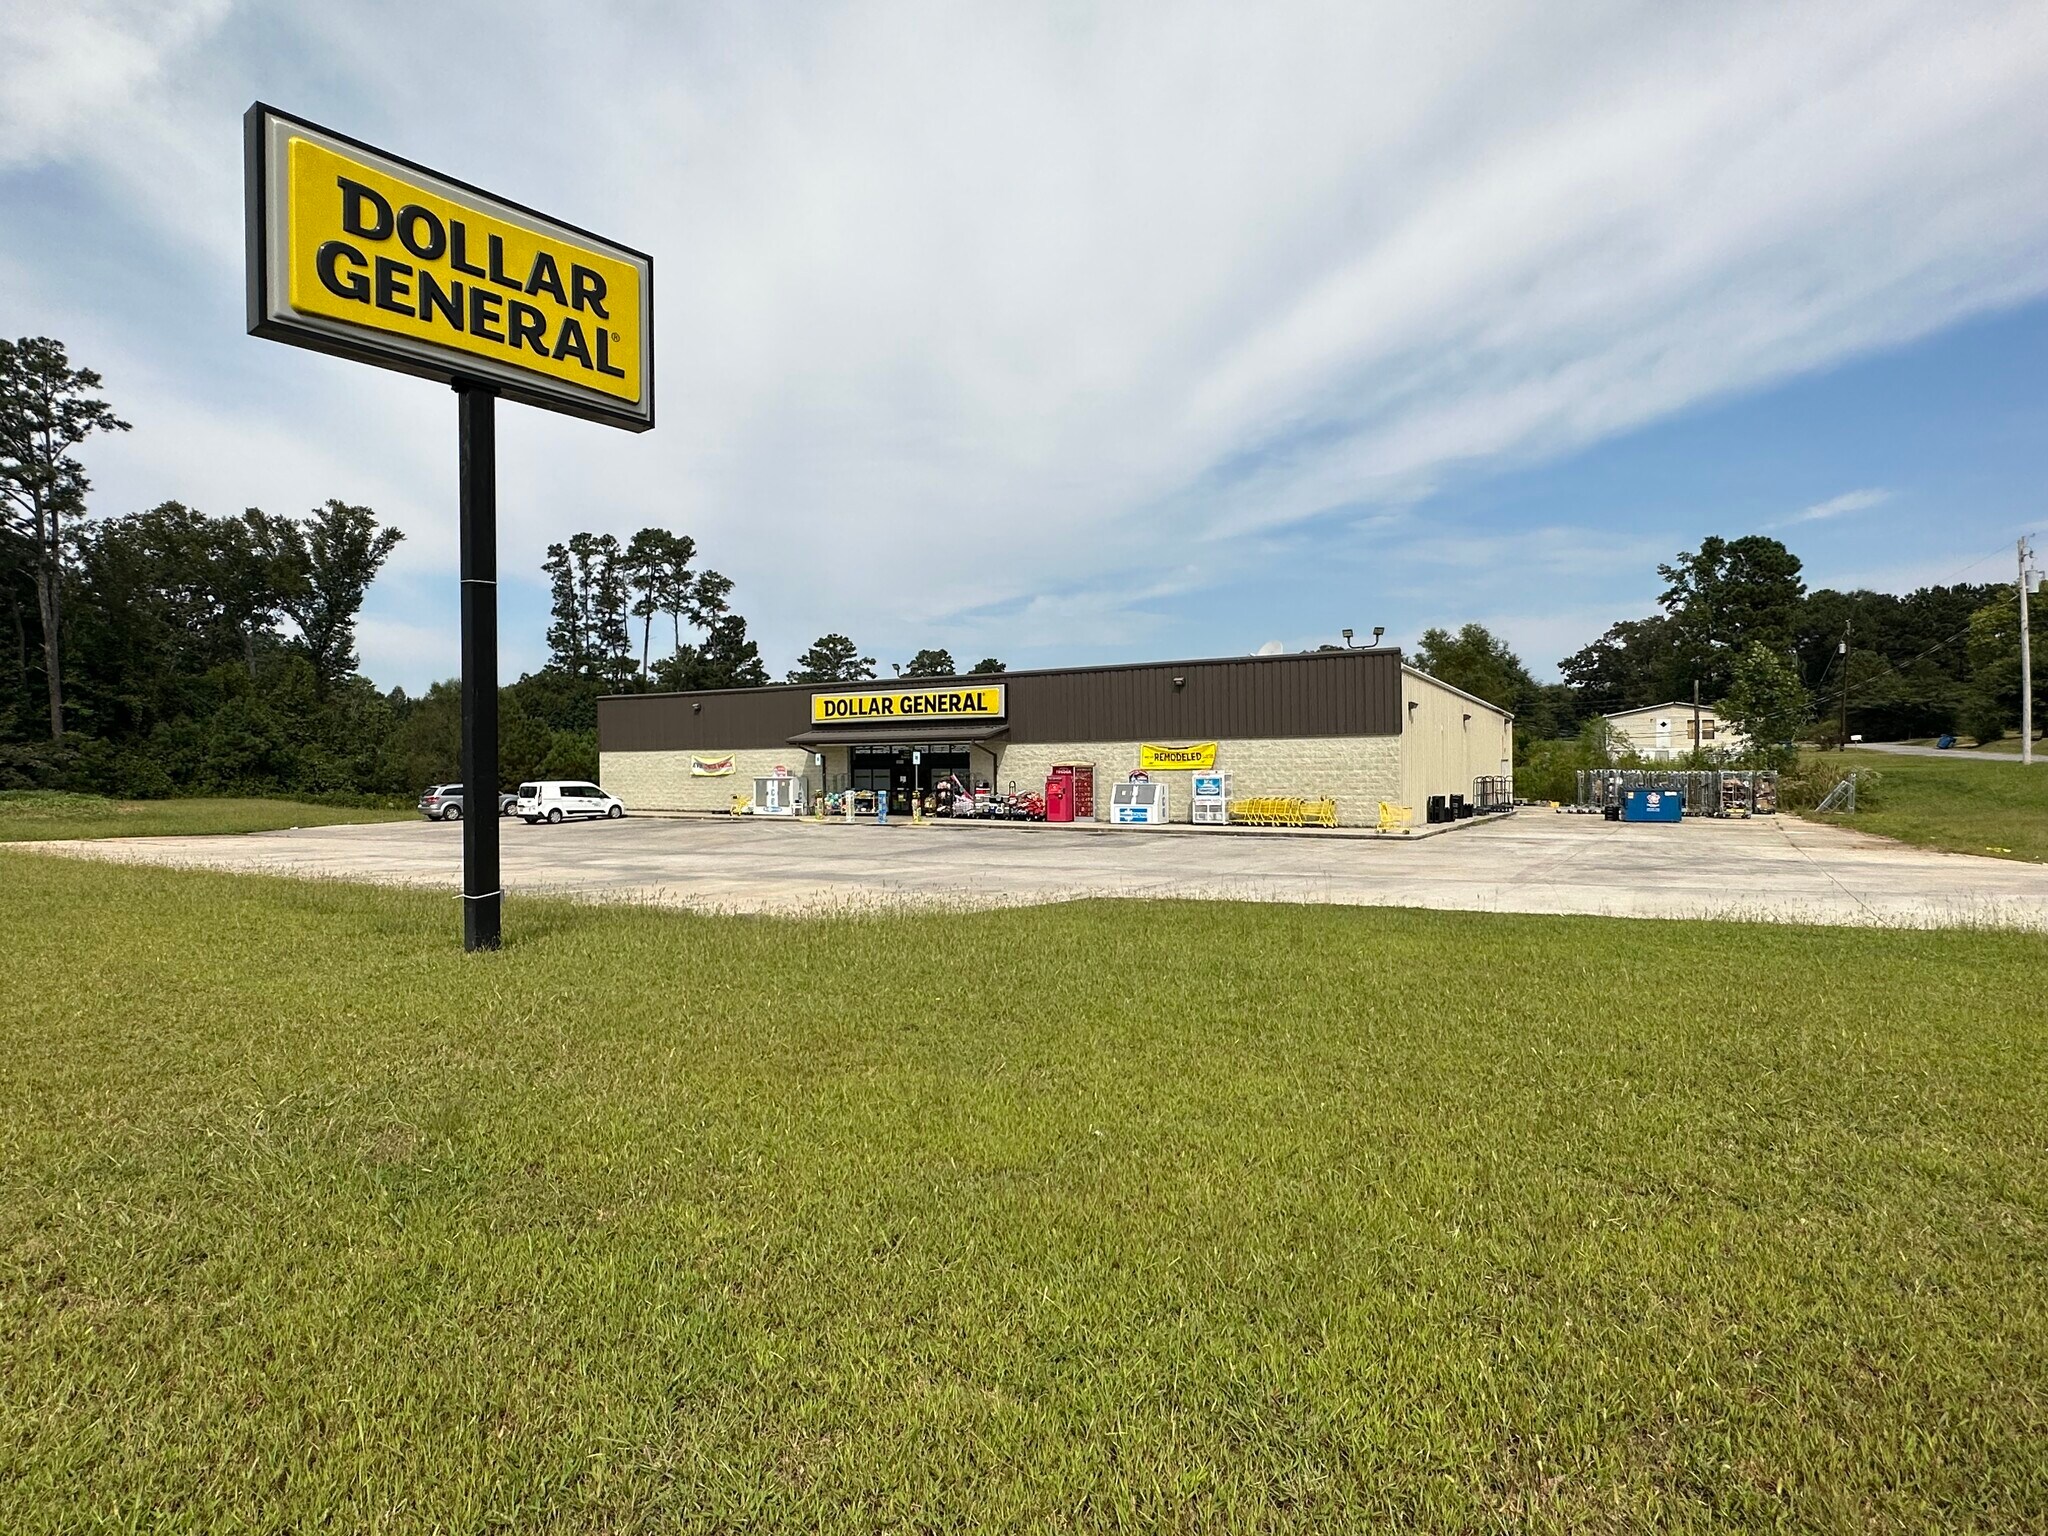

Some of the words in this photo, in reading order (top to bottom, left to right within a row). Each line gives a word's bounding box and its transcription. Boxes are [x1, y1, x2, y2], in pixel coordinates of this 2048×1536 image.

[337, 176, 610, 319] DOLLAR
[316, 241, 625, 379] GENERAL
[824, 697, 894, 717] DOLLAR
[900, 692, 988, 714] GENERAL
[1154, 752, 1202, 762] REMODELED
